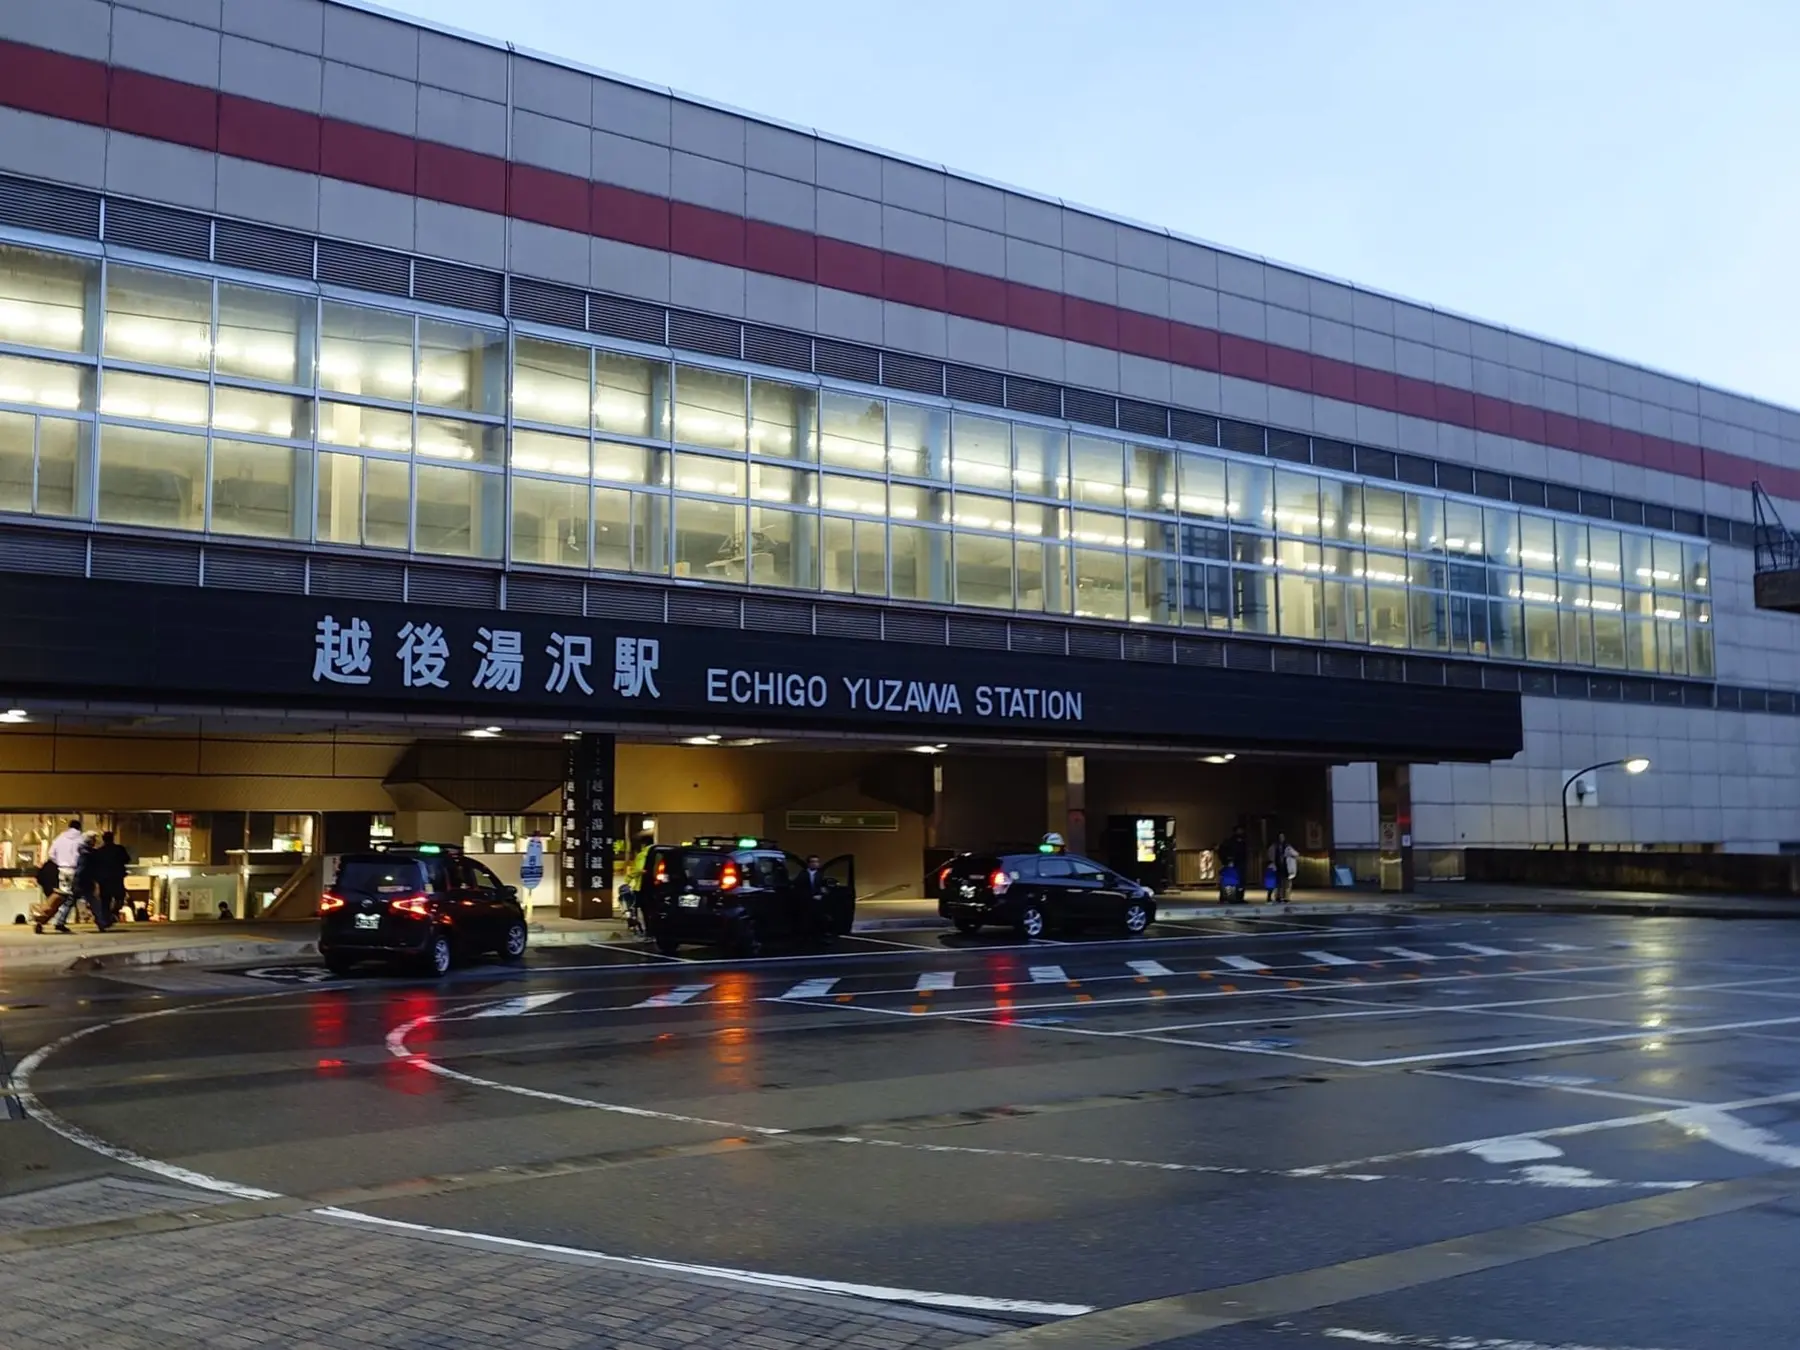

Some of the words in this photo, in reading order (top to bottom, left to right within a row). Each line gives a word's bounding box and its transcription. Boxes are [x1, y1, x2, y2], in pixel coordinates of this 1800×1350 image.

[312, 615, 660, 698] 越後湯沢駅
[706, 667, 828, 708] ECHIGO
[843, 676, 962, 715] YUZAWA
[975, 685, 1083, 721] STATION
